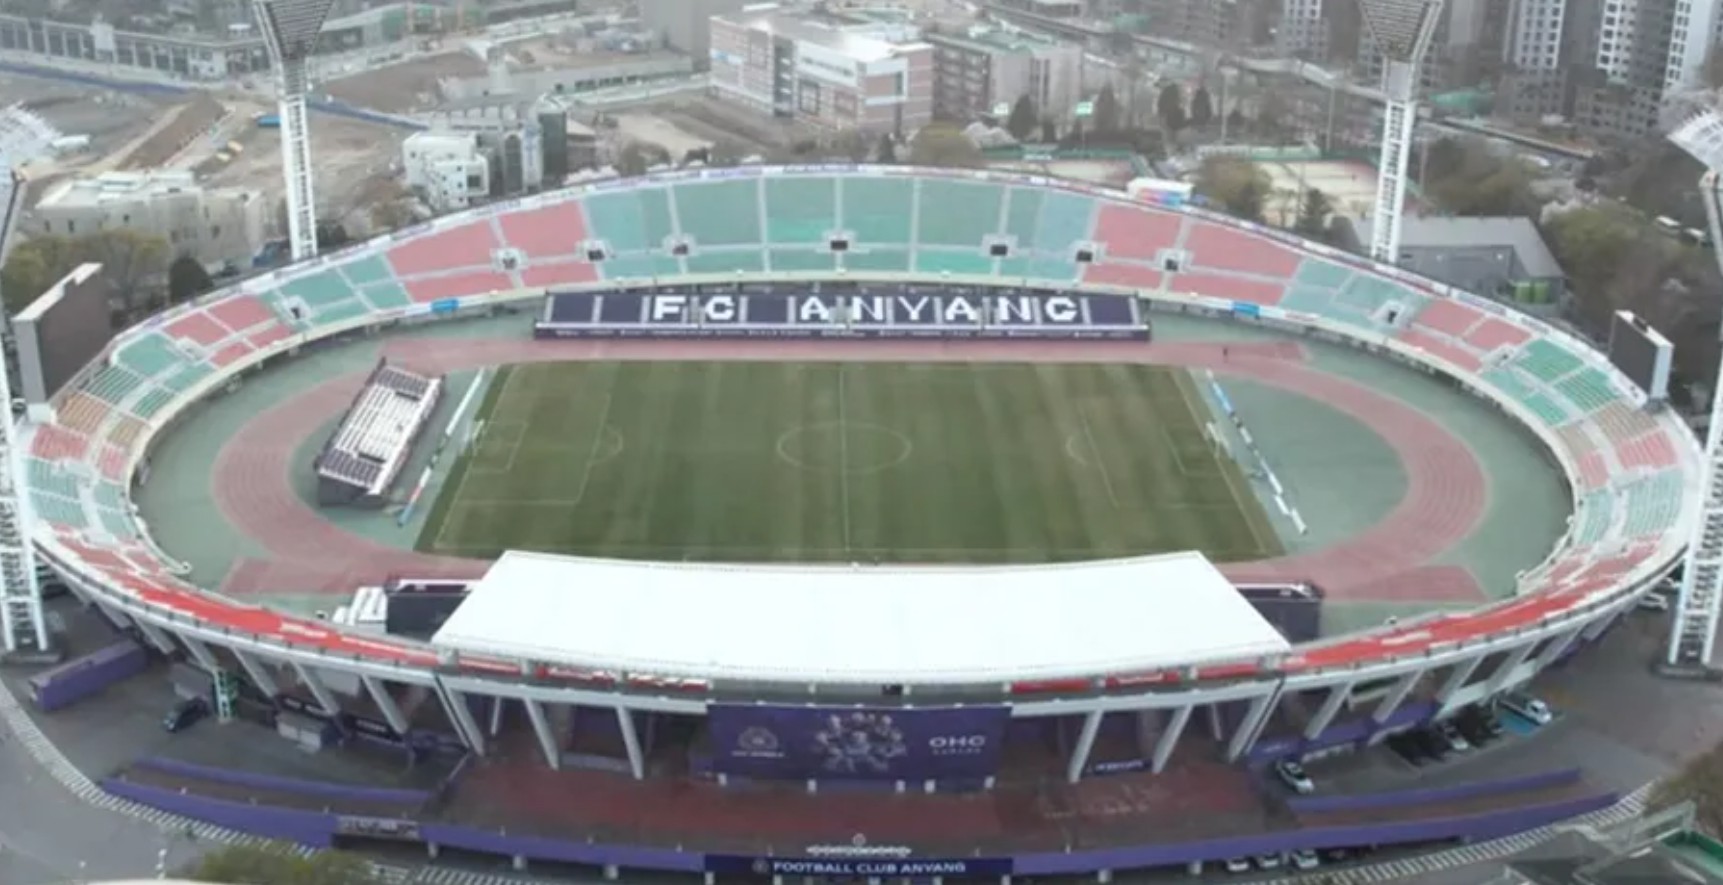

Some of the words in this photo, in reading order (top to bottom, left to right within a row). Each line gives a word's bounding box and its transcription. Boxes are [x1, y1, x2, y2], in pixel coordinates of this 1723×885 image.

[653, 295, 735, 321] FC
[800, 296, 1078, 322] ANYANG
[774, 862, 853, 874] FOOTBALL
[856, 863, 897, 874] CLUB
[900, 862, 966, 874] ANYANG
